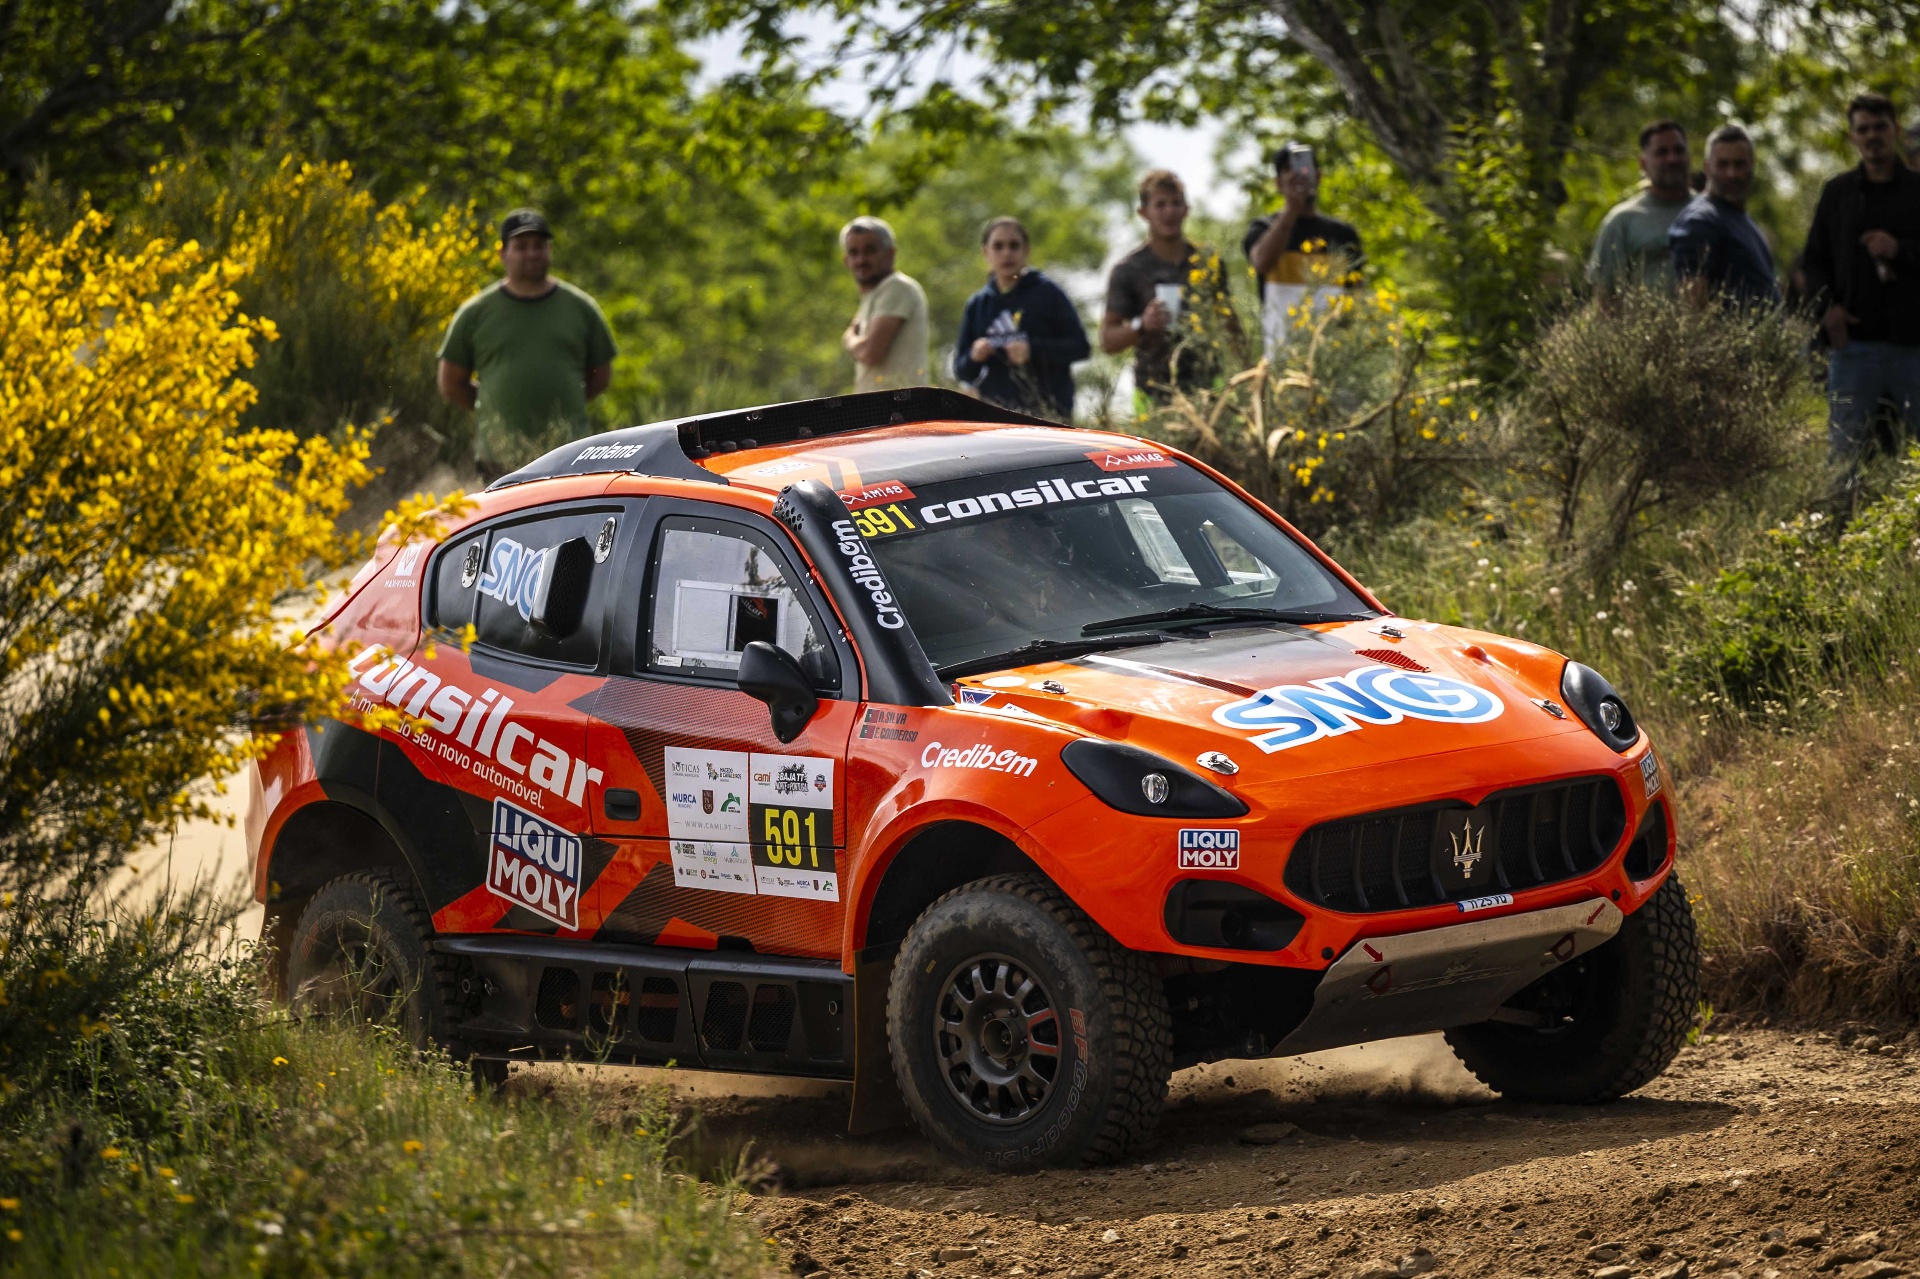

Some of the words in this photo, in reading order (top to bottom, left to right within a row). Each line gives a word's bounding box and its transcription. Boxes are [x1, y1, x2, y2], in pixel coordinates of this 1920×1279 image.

[571, 442, 644, 466] prolama
[920, 475, 1150, 524] consilcar
[852, 504, 916, 537] 591
[831, 519, 904, 630] Credibom
[413, 731, 437, 752] seu
[438, 742, 470, 770] novo
[473, 761, 545, 810] automóvel.
[921, 742, 1038, 777] Credibom
[754, 772, 771, 782] cami
[779, 772, 796, 781] BAJA
[685, 820, 732, 831] WWW.CAMI.PT
[765, 808, 819, 868] 591
[1183, 832, 1236, 849] LIQUI
[498, 807, 575, 878] LIQUI
[1183, 850, 1237, 866] MOLY
[494, 849, 575, 919] MOLY
[1478, 897, 1492, 907] 25
